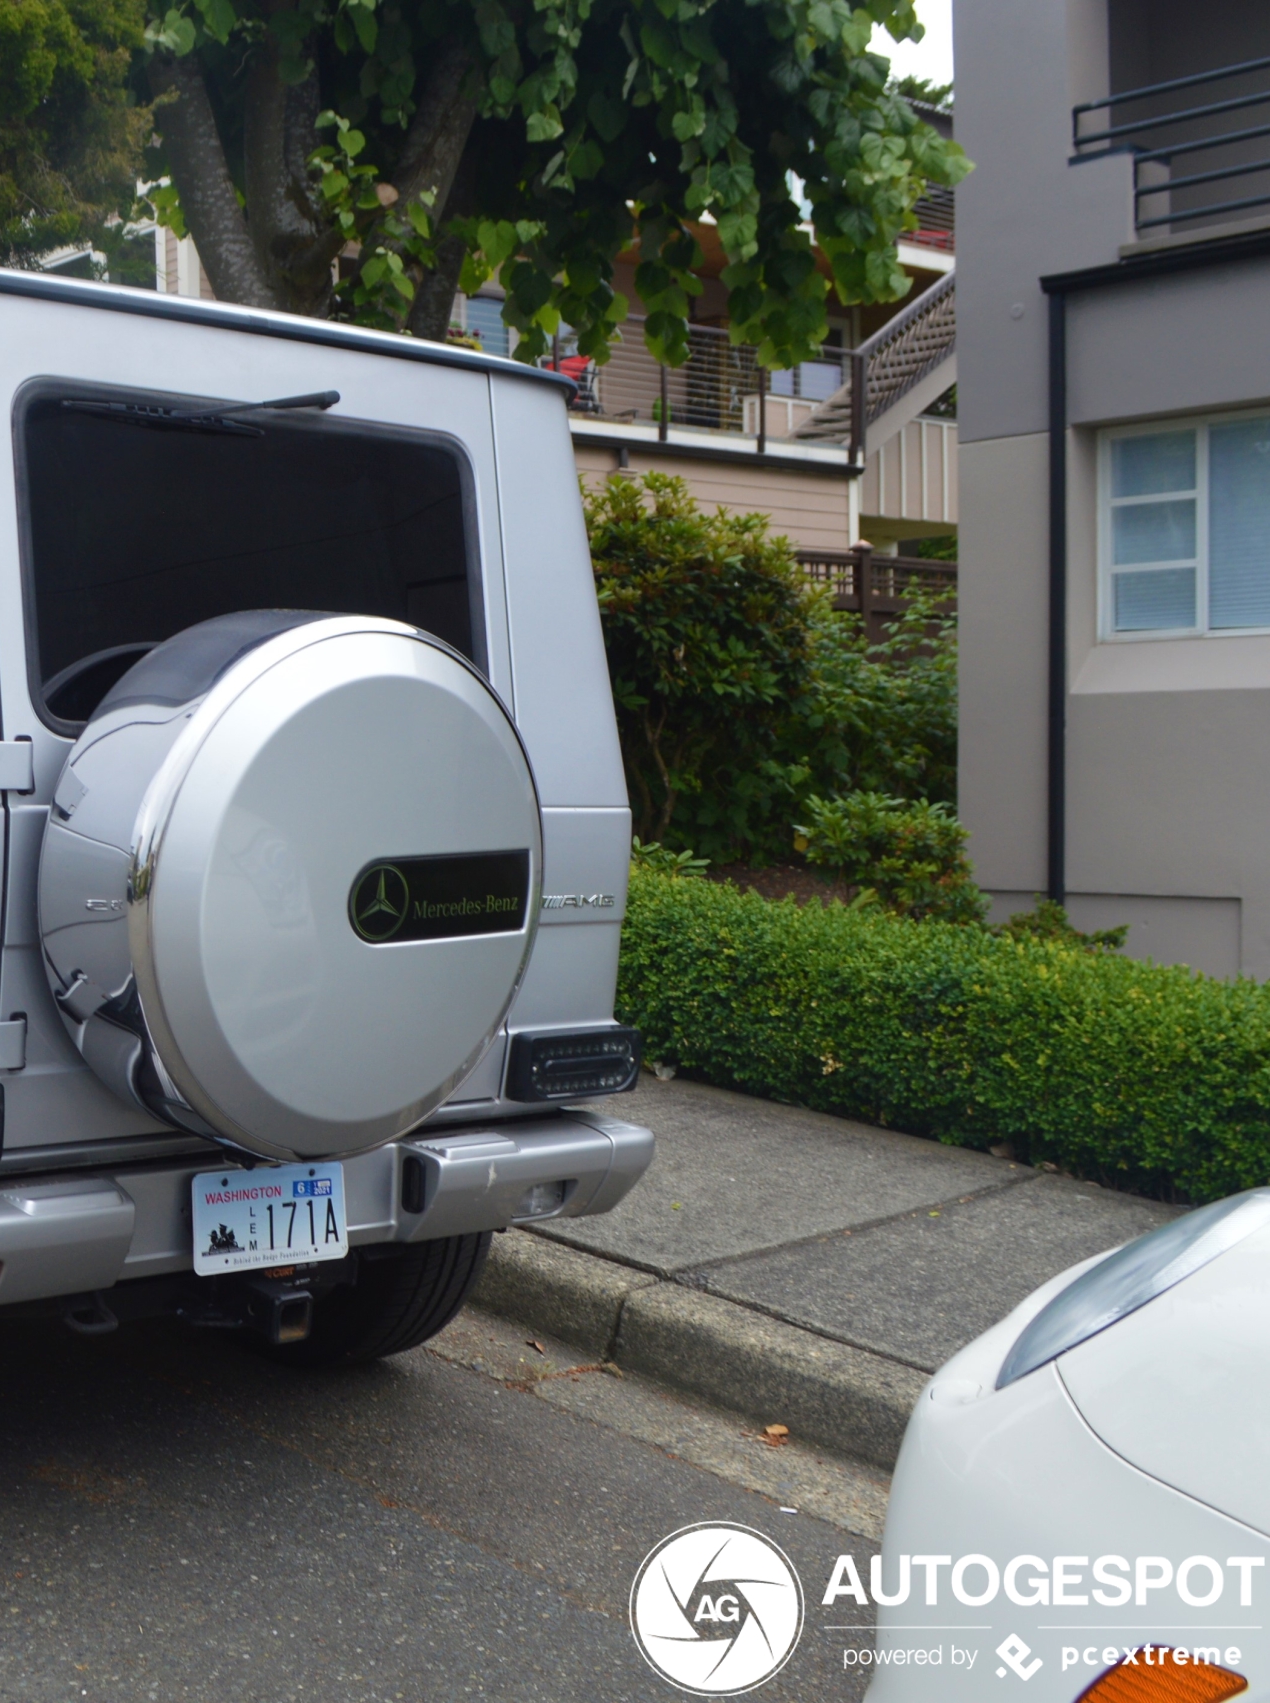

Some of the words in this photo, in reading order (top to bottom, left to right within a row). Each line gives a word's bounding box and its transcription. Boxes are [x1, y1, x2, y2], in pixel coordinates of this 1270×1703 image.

[413, 895, 518, 919] Mercedes-Benz
[205, 1186, 282, 1205] WASHINGTON
[297, 1182, 305, 1194] 6
[314, 1187, 330, 1195] 2021
[266, 1198, 339, 1250] 171A
